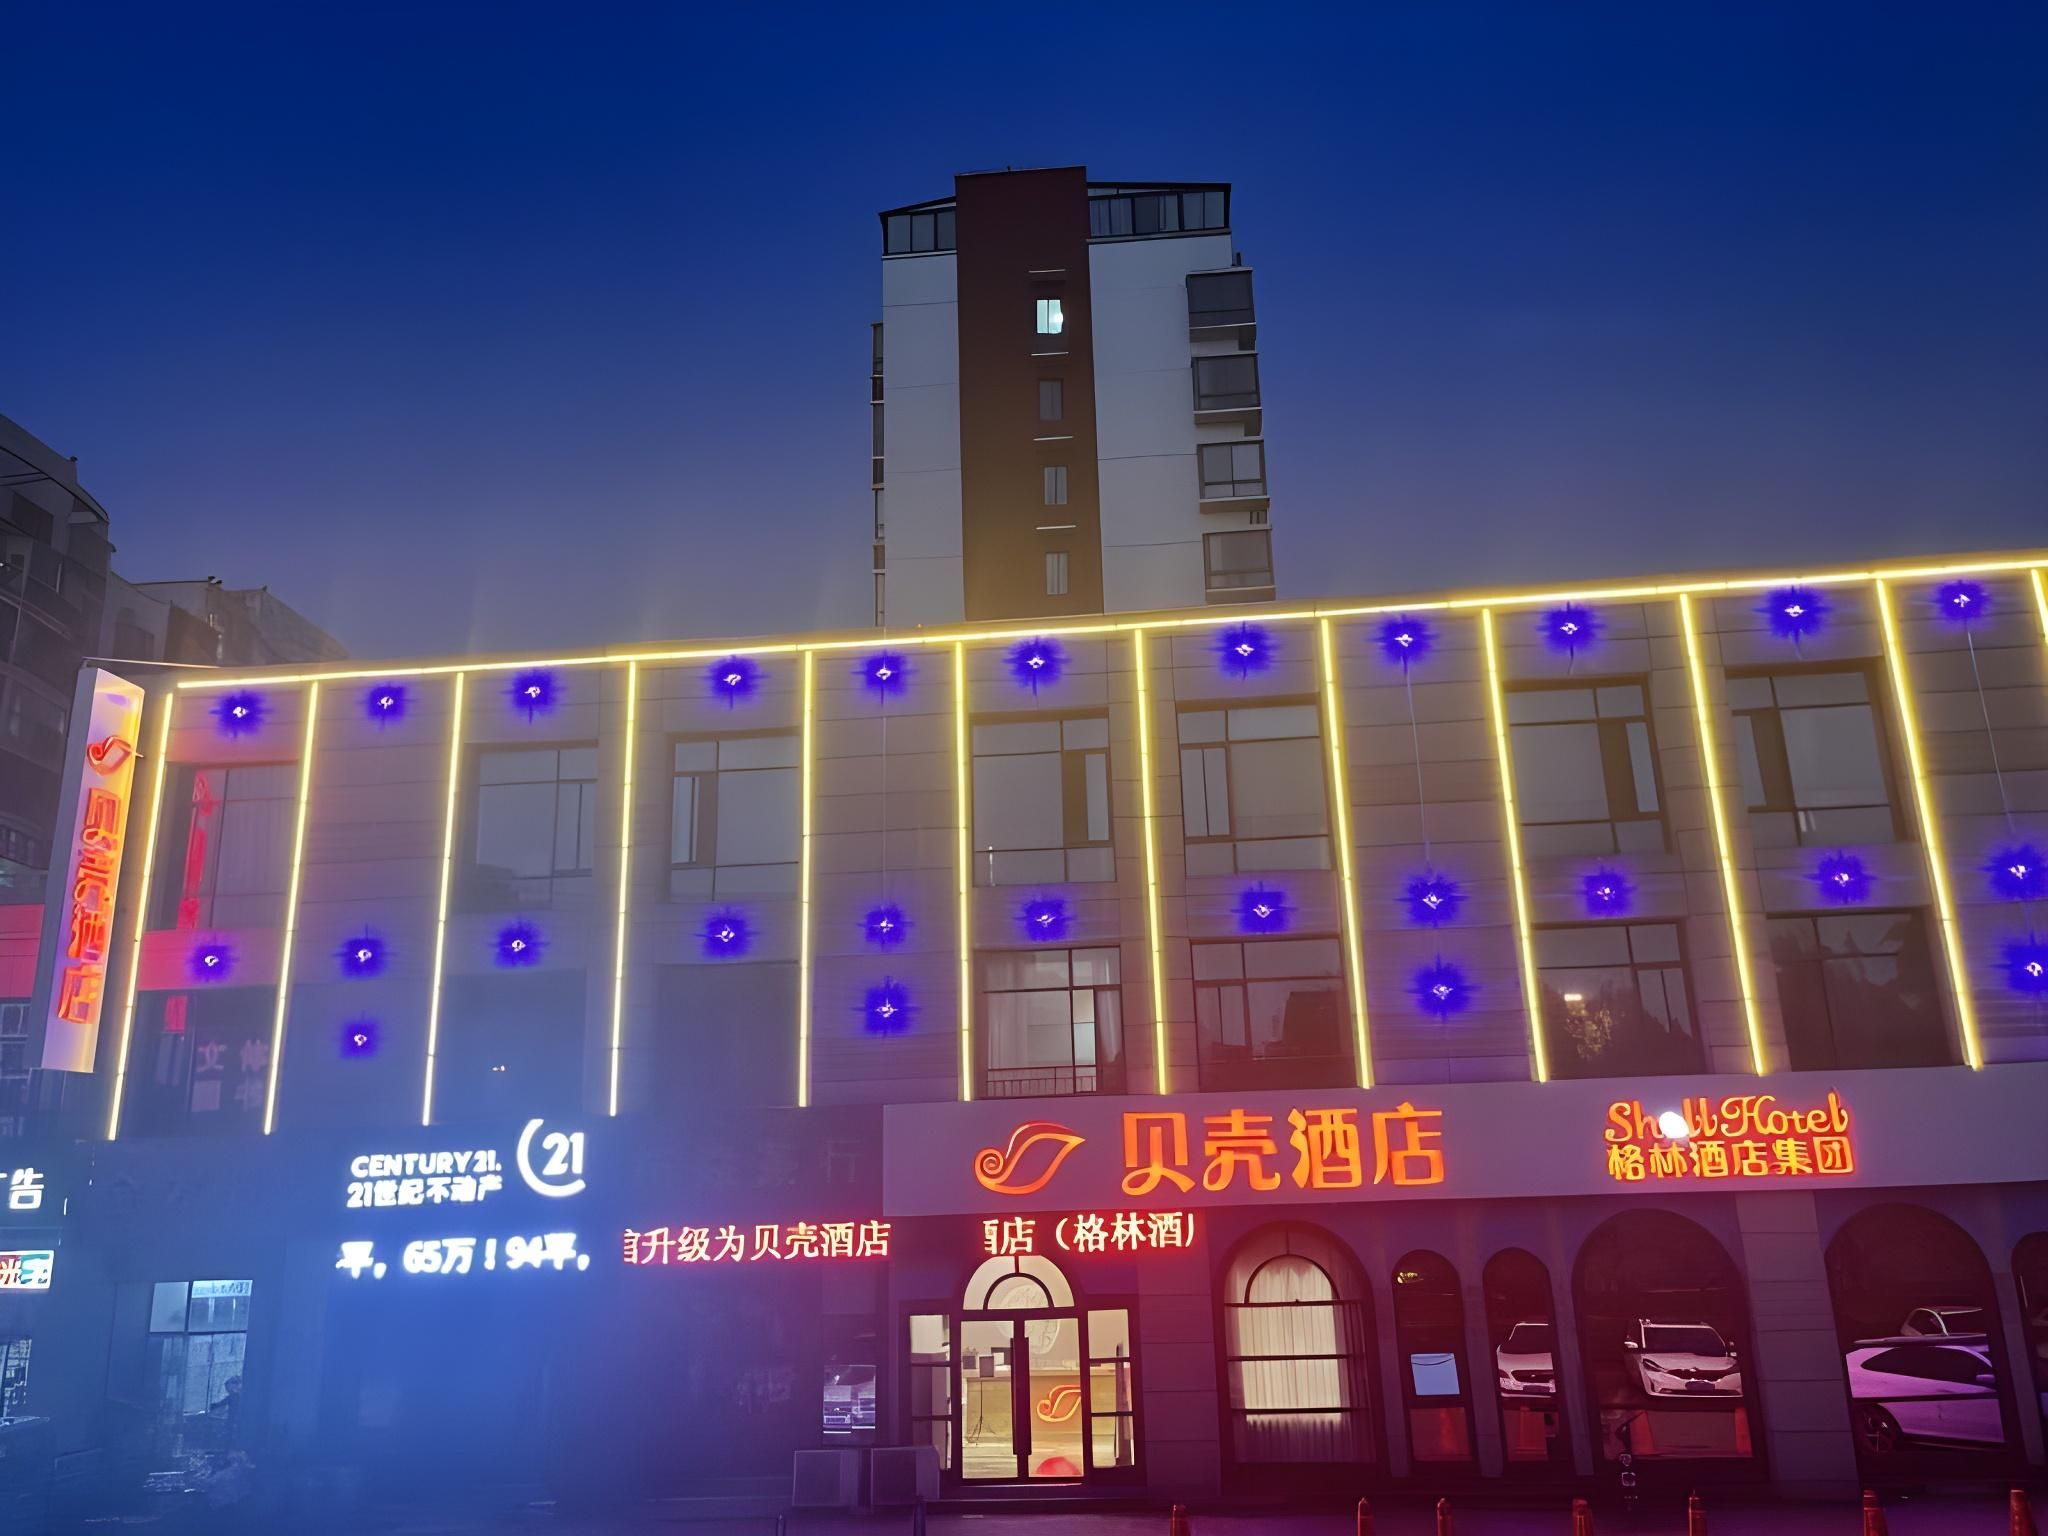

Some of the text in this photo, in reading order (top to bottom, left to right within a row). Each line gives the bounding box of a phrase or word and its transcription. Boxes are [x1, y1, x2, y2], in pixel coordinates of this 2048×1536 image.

[1604, 1090, 1849, 1142] Shll Hotel
[1120, 1101, 1446, 1196] 贝壳酒店
[1607, 1135, 1855, 1181] 格林酒店集团
[0, 1167, 45, 1209] 告
